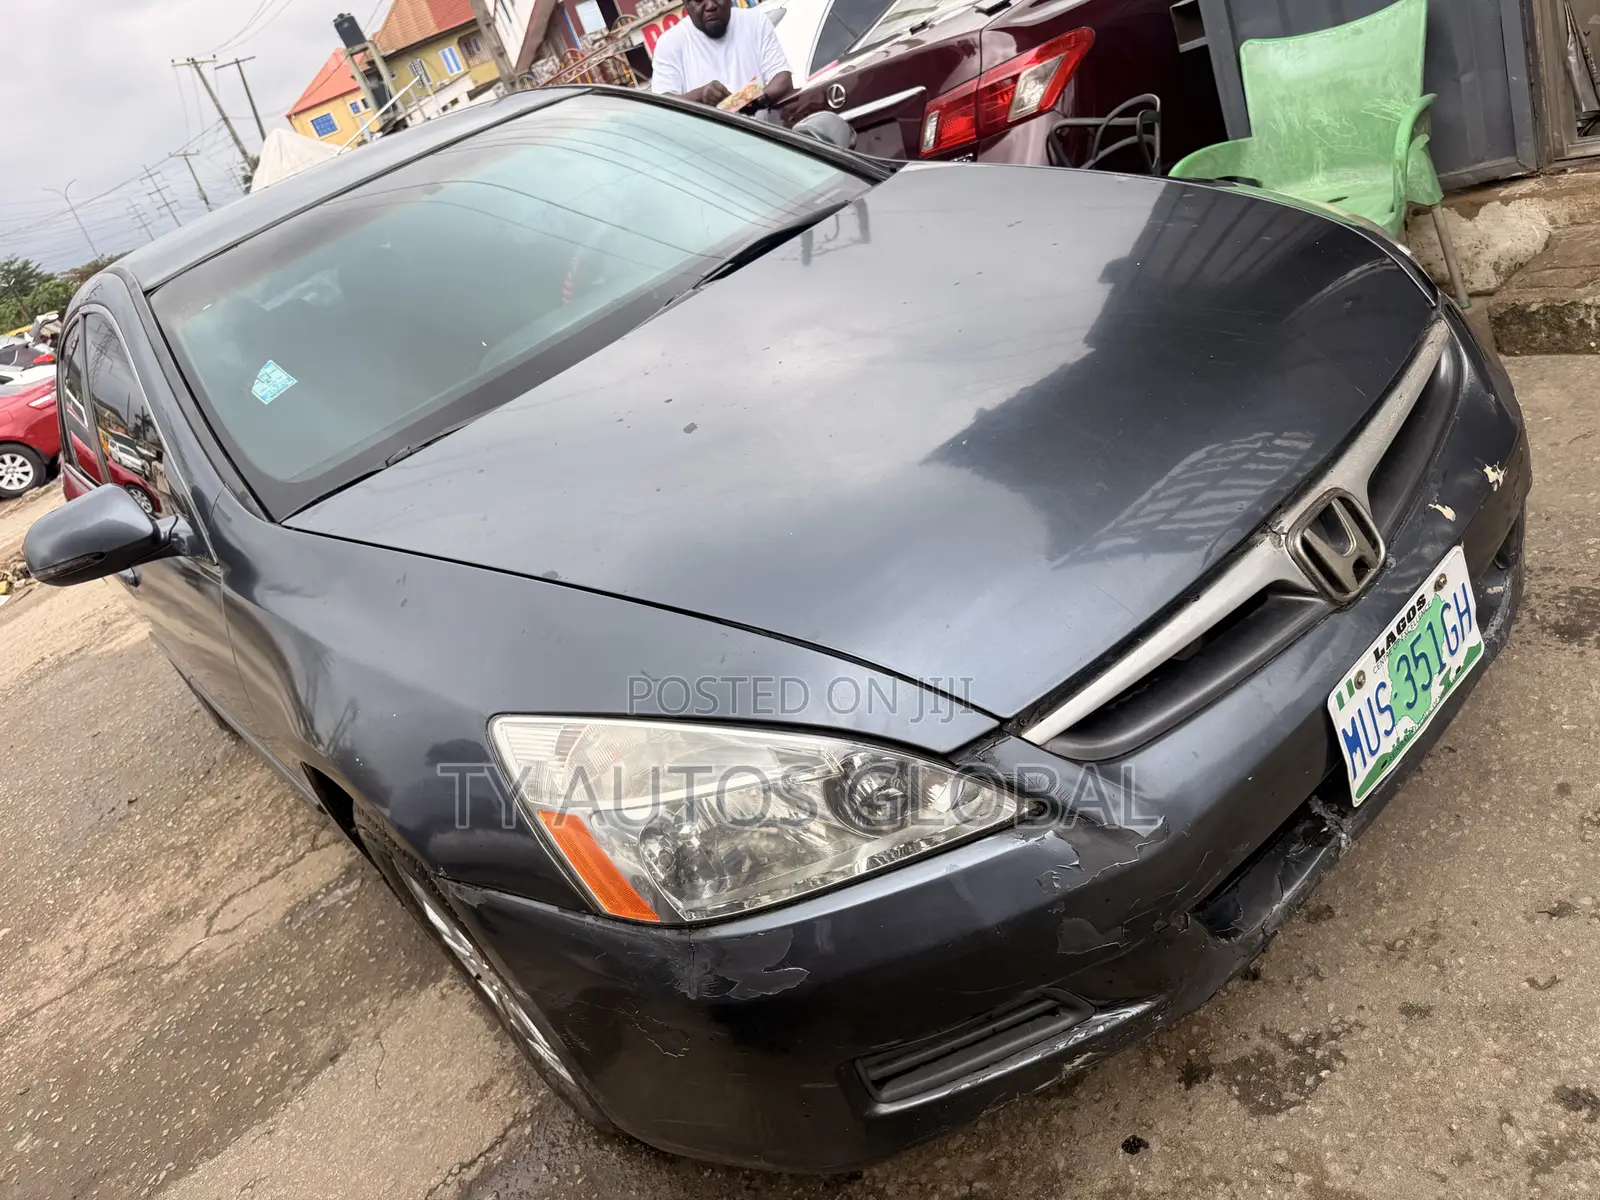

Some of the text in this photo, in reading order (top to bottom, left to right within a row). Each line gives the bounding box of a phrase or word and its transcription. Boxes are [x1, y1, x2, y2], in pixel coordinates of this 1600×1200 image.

[1372, 647, 1392, 675] CENTRE
[1400, 600, 1432, 642] EXCELLENCE
[1373, 593, 1426, 663] LAGOS
